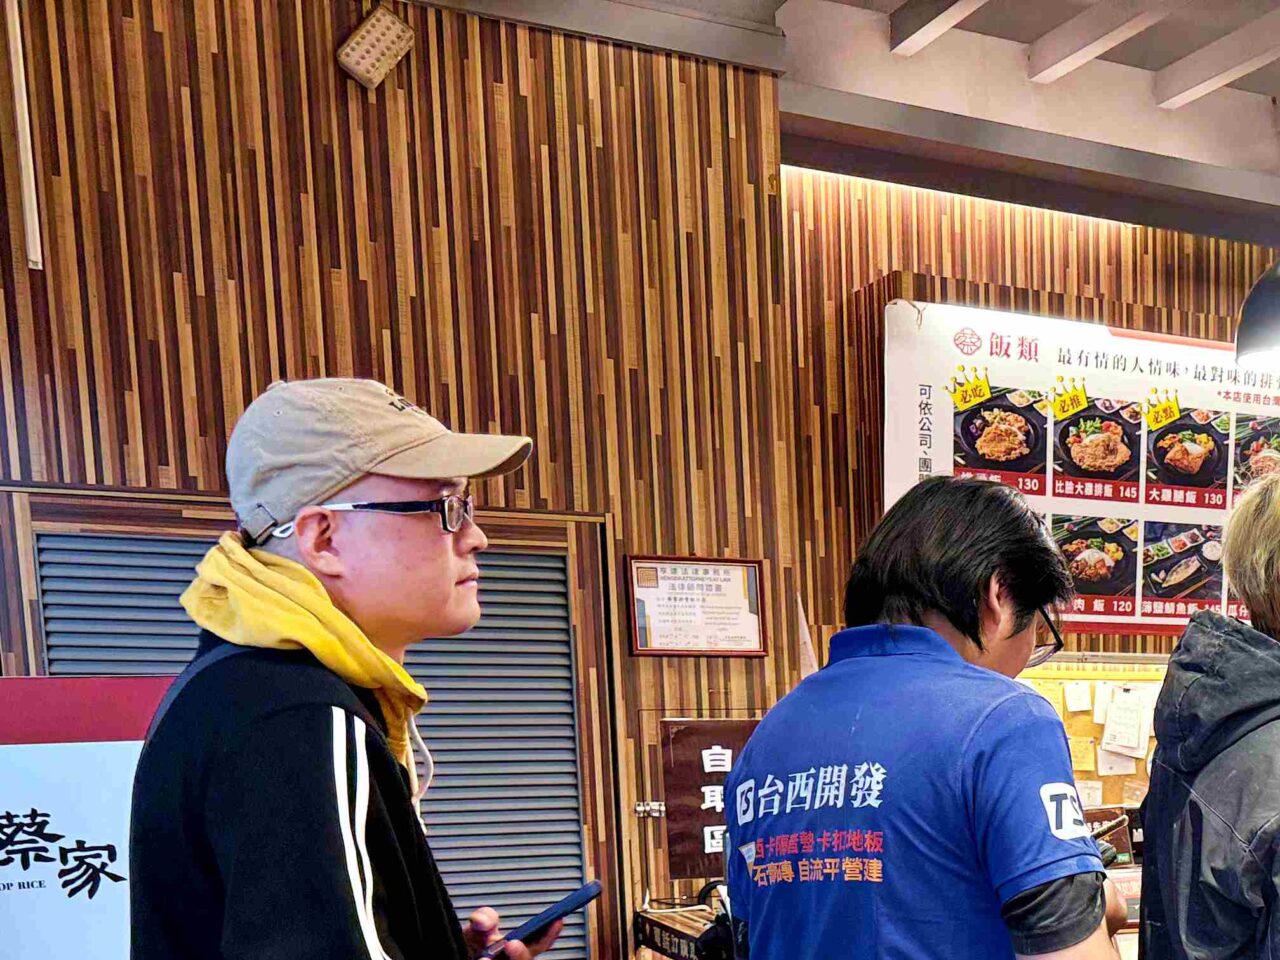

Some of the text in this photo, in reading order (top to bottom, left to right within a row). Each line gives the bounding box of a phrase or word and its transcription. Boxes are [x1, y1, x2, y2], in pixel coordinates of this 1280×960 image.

[989, 333, 1040, 363] 飯類
[960, 384, 985, 404] 必吃
[1058, 396, 1082, 413] 必推
[1017, 478, 1039, 491] 130
[1119, 485, 1137, 499] 145
[1148, 489, 1197, 504] 大雞腿飯
[1203, 492, 1223, 505] 130
[1113, 600, 1132, 612] 120
[758, 761, 888, 819] 台西開發
[0, 807, 129, 900] 蔡家
[18, 880, 47, 890] RICE
